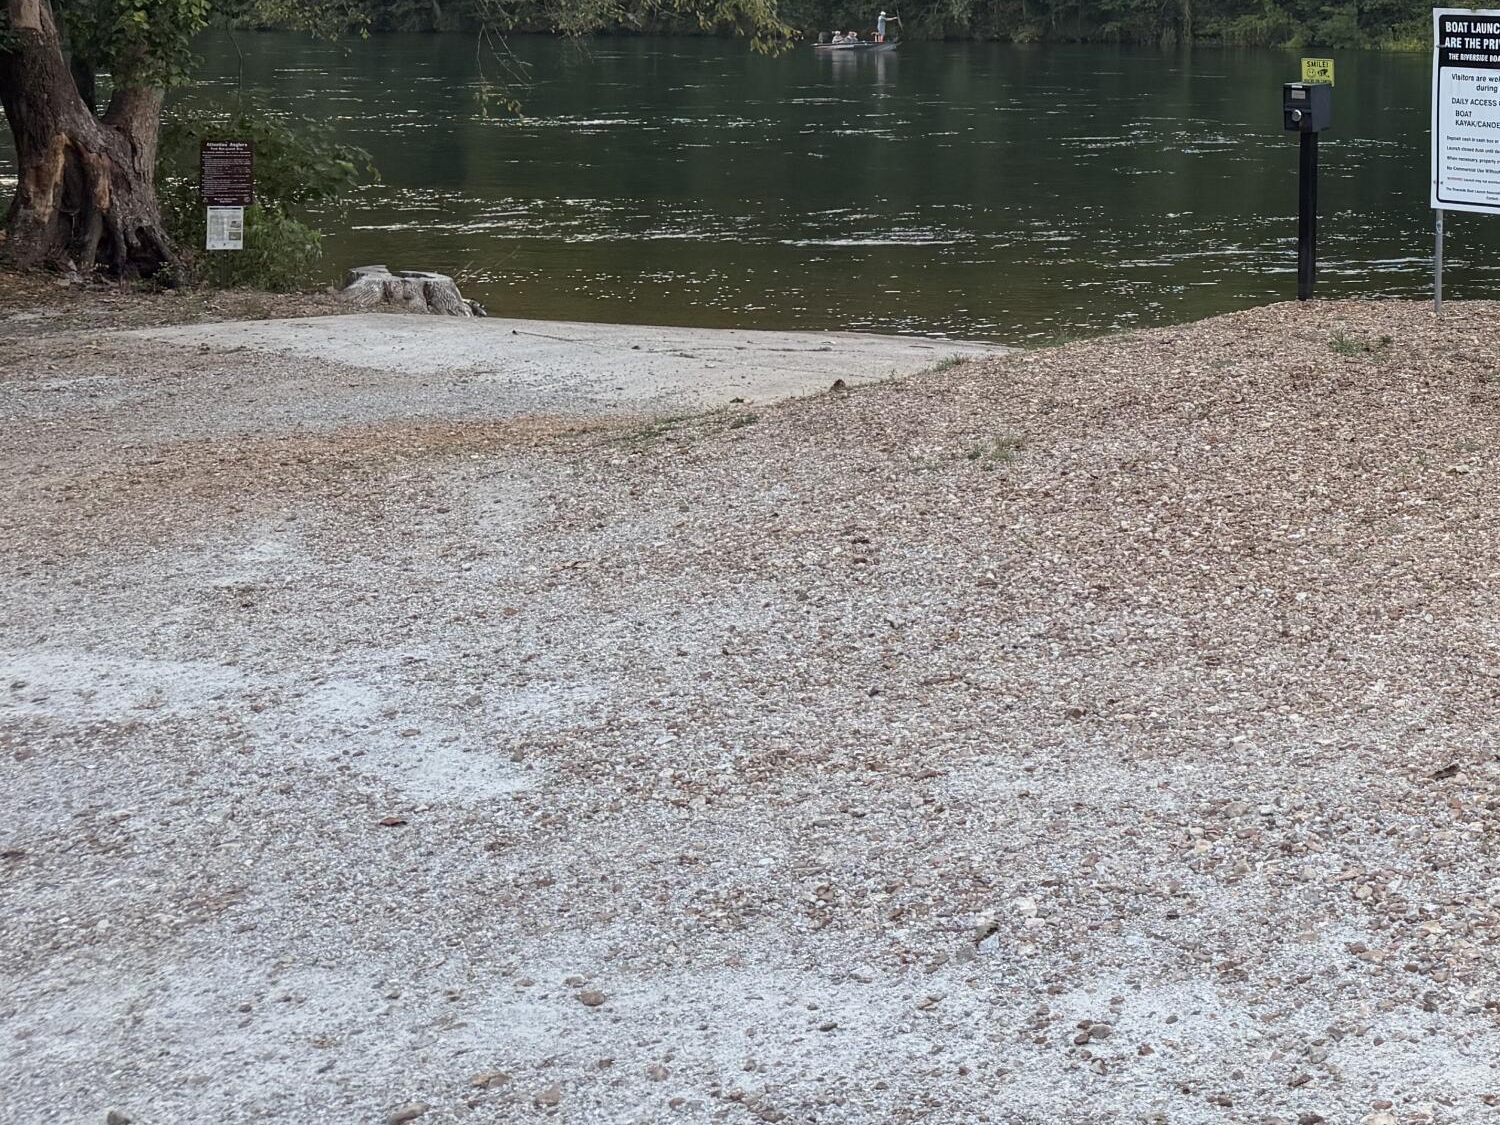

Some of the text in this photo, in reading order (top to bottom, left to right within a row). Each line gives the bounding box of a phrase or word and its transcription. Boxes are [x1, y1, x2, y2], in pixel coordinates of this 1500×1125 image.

[1445, 21, 1469, 33] BOAT
[1444, 37, 1462, 49] ARE
[1464, 38, 1481, 49] THE
[1448, 52, 1460, 61] THE
[1460, 54, 1489, 62] RIVERSIDE
[1451, 73, 1475, 82] Visitors
[1476, 84, 1498, 94] during
[1451, 97, 1469, 105] DAILY
[1470, 98, 1498, 107] ACCESS
[1455, 109, 1472, 118] BOAT
[1455, 119, 1500, 129] KAYAK/CANOE
